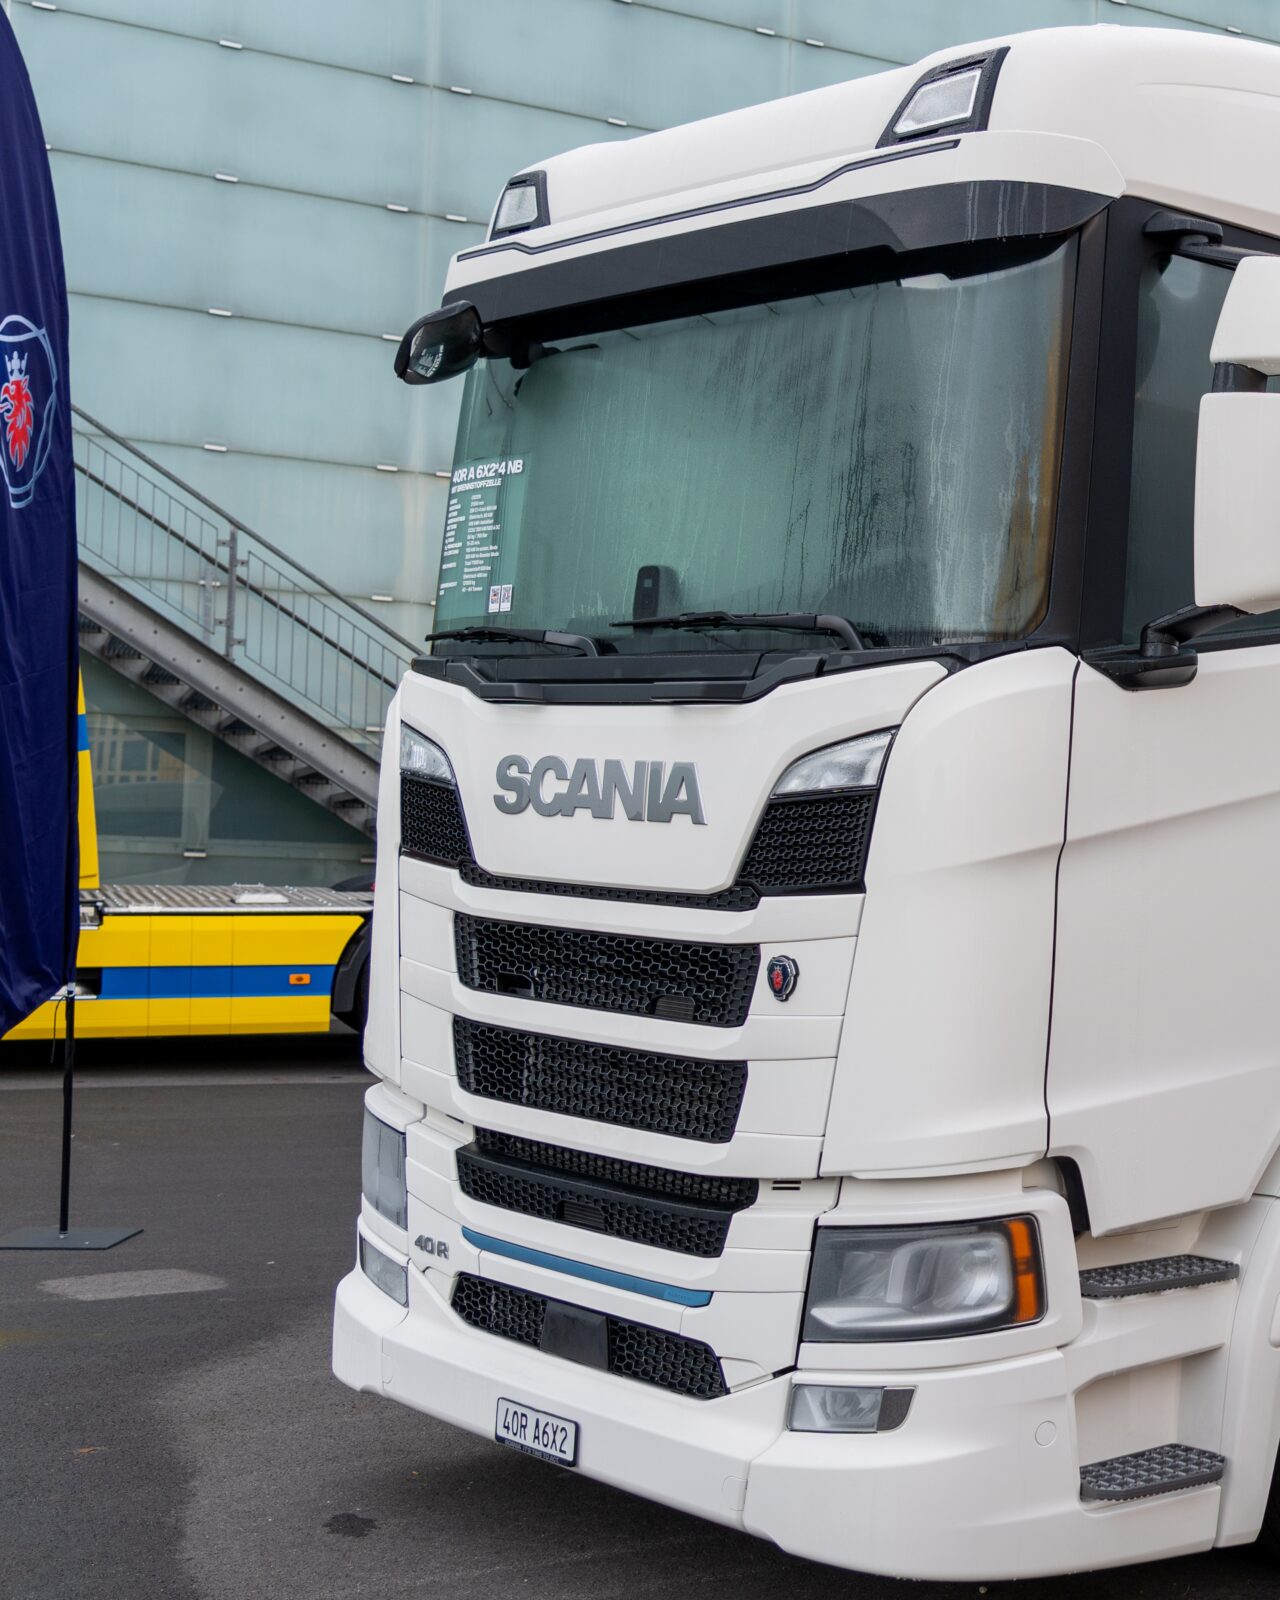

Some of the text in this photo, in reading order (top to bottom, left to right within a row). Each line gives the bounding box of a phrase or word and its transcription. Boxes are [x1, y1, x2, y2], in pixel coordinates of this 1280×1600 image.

[452, 468, 468, 483] 40R
[468, 466, 474, 480] A
[507, 460, 522, 474] NB
[494, 754, 708, 826] SCANIA
[502, 1407, 568, 1455] 40R A6X2
